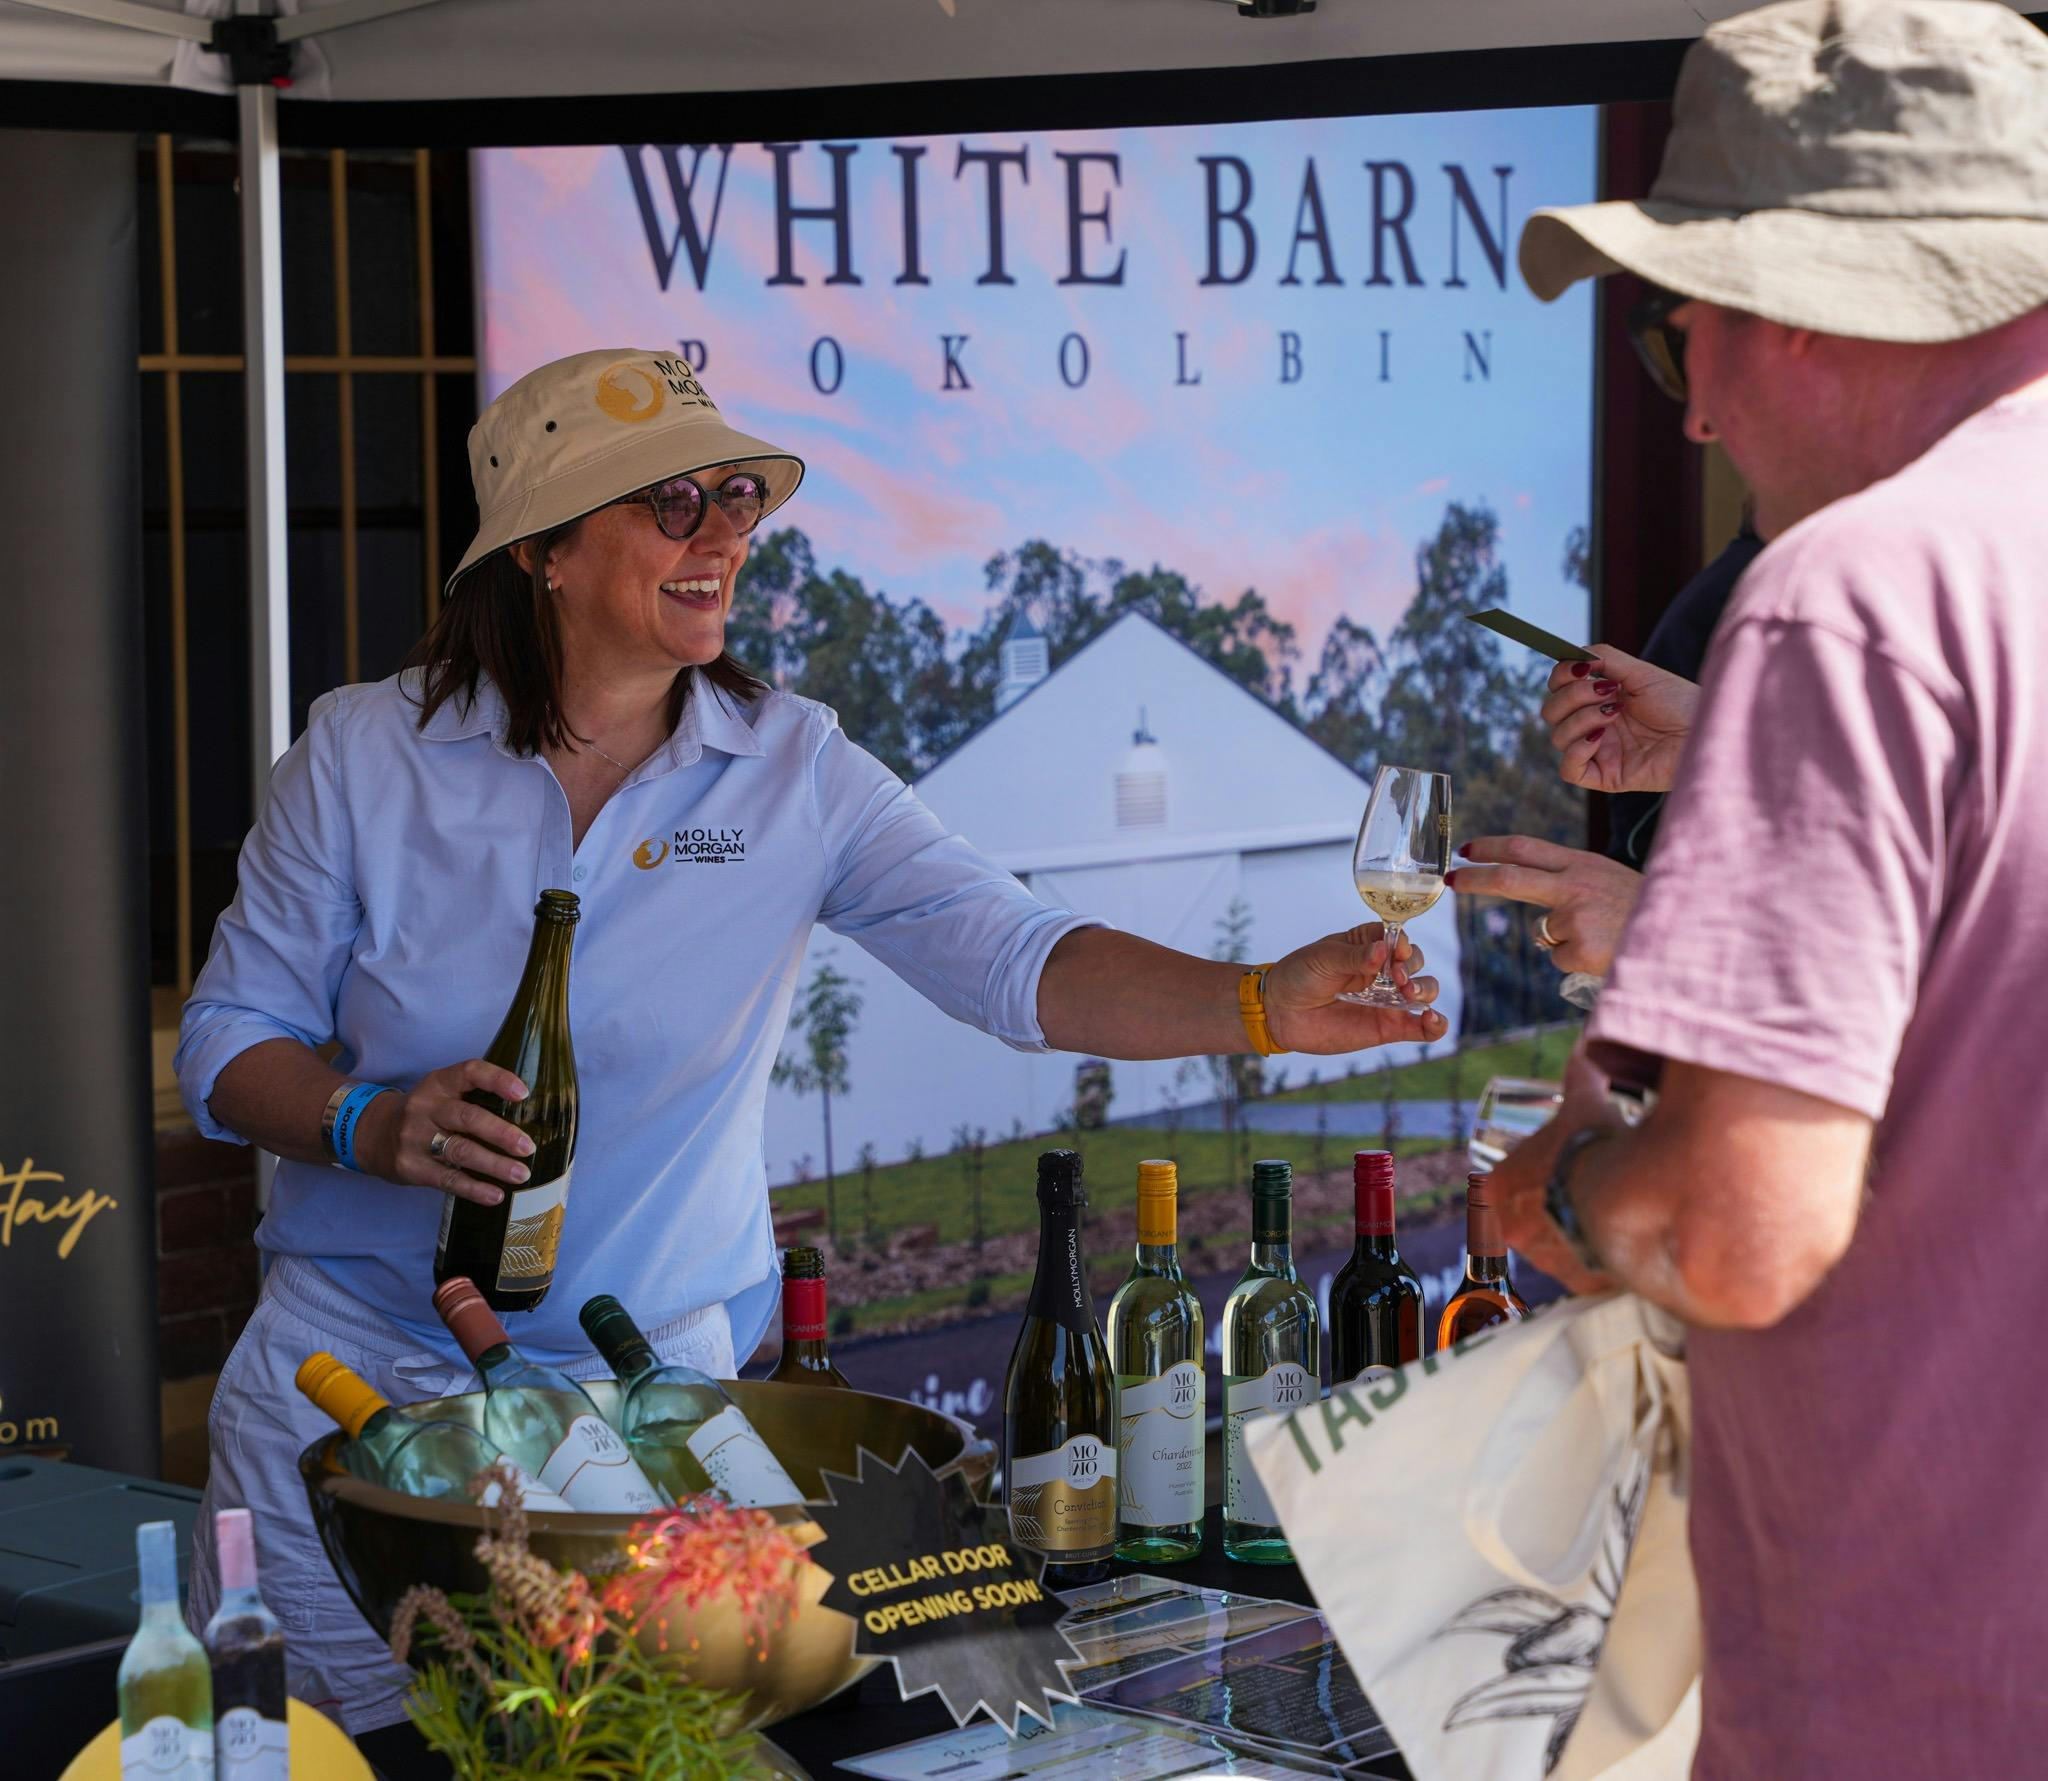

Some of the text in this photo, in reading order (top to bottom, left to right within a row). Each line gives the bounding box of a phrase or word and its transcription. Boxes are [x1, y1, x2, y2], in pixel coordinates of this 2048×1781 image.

[619, 141, 1515, 292] WHITE BARN
[654, 359, 691, 377] MO
[675, 829, 743, 842] MOLLY
[675, 843, 744, 855] MORGAN
[340, 1105, 354, 1156] VENDOR
[0, 1157, 118, 1259] tay.
[1175, 1372, 1196, 1386] MO
[1277, 1372, 1302, 1386] MO
[0, 1416, 58, 1445] om
[1073, 1444, 1098, 1459] MO
[848, 1544, 1012, 1596] CELLAR DOOR
[864, 1579, 1044, 1634] OPENING SOON!
